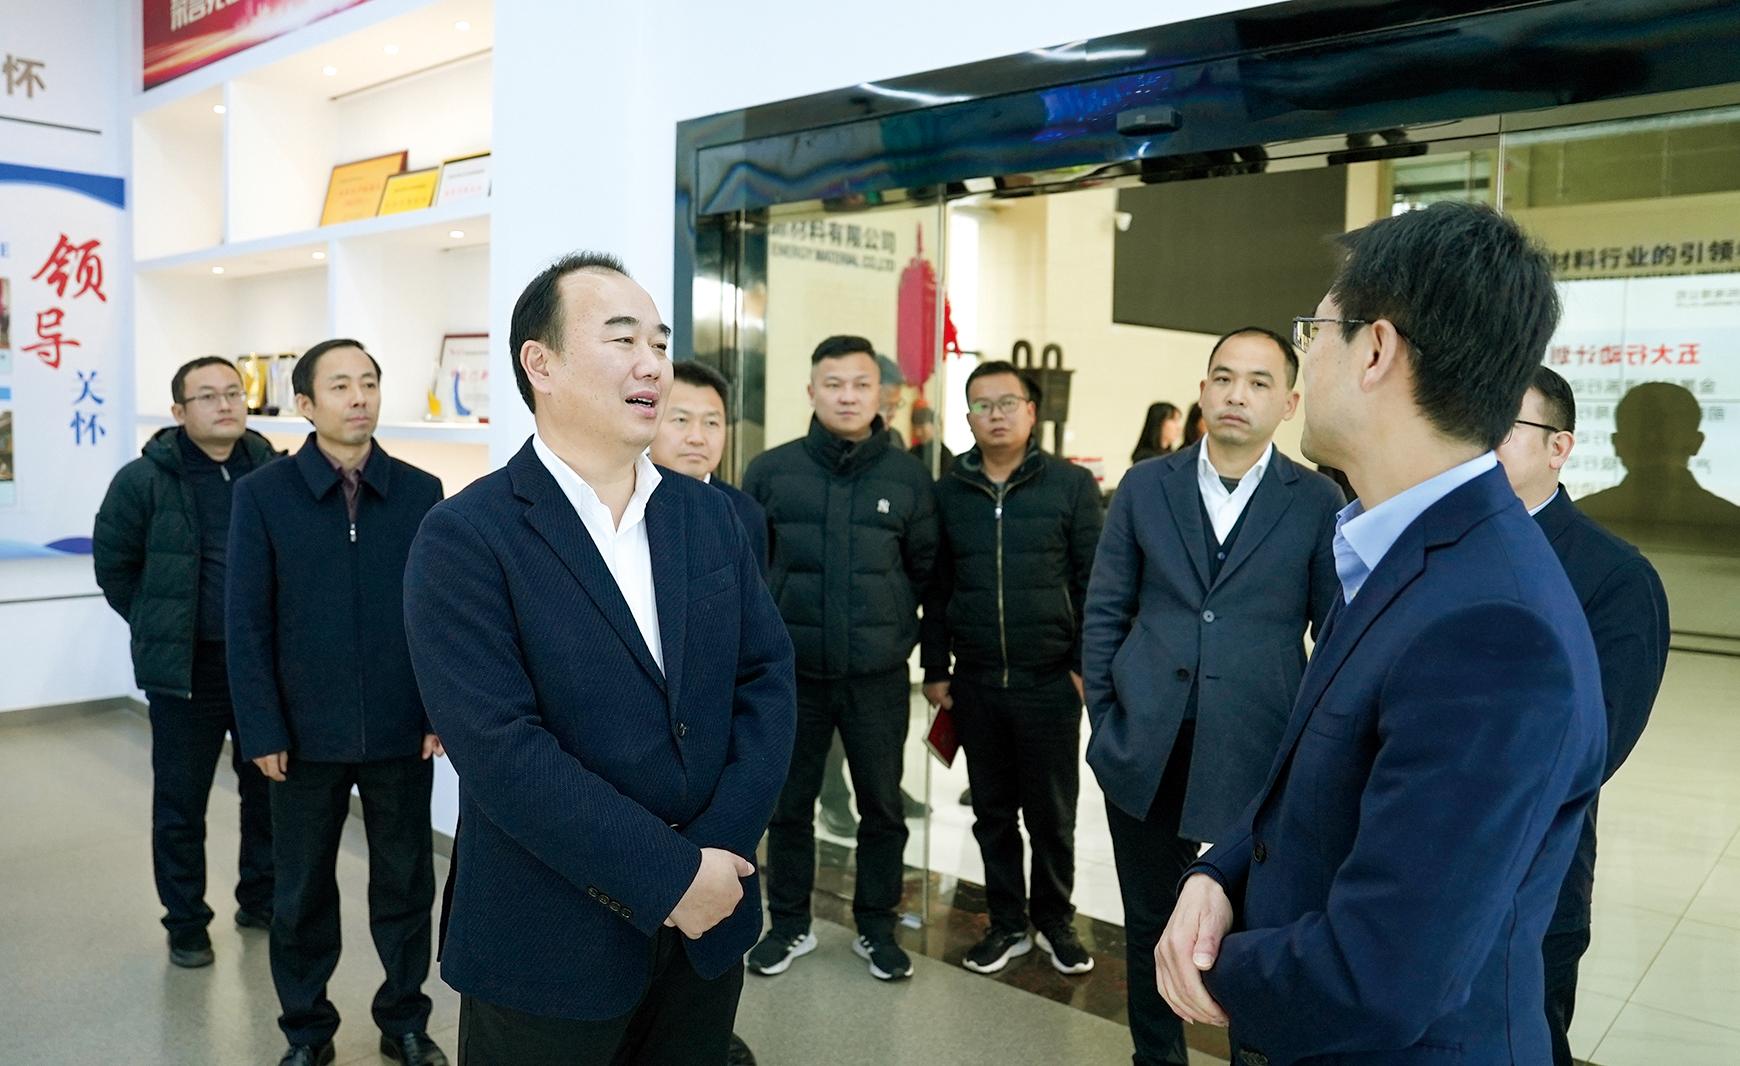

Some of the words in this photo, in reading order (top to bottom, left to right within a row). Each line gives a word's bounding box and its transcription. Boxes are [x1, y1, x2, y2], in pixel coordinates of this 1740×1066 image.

[2, 53, 46, 98] 怀
[1551, 239, 1740, 271] 材料行业的引领
[21, 233, 107, 369] 领导
[70, 369, 106, 446] 关怀
